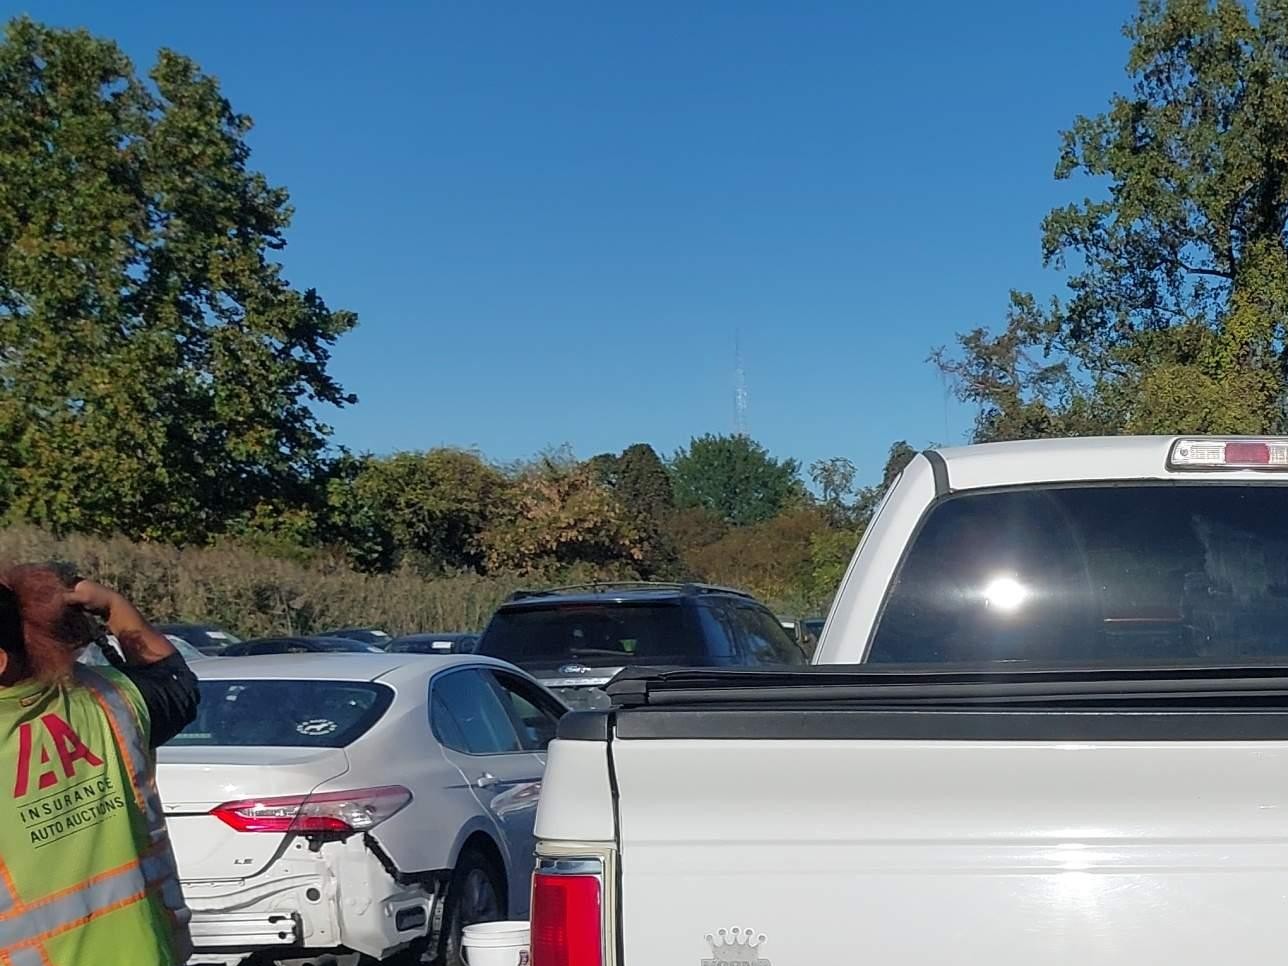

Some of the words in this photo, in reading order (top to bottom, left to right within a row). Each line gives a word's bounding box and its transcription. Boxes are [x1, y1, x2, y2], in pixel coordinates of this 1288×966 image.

[20, 777, 114, 823] INSURANCE
[30, 821, 64, 843] AUTO
[66, 796, 125, 829] AUCTIONS
